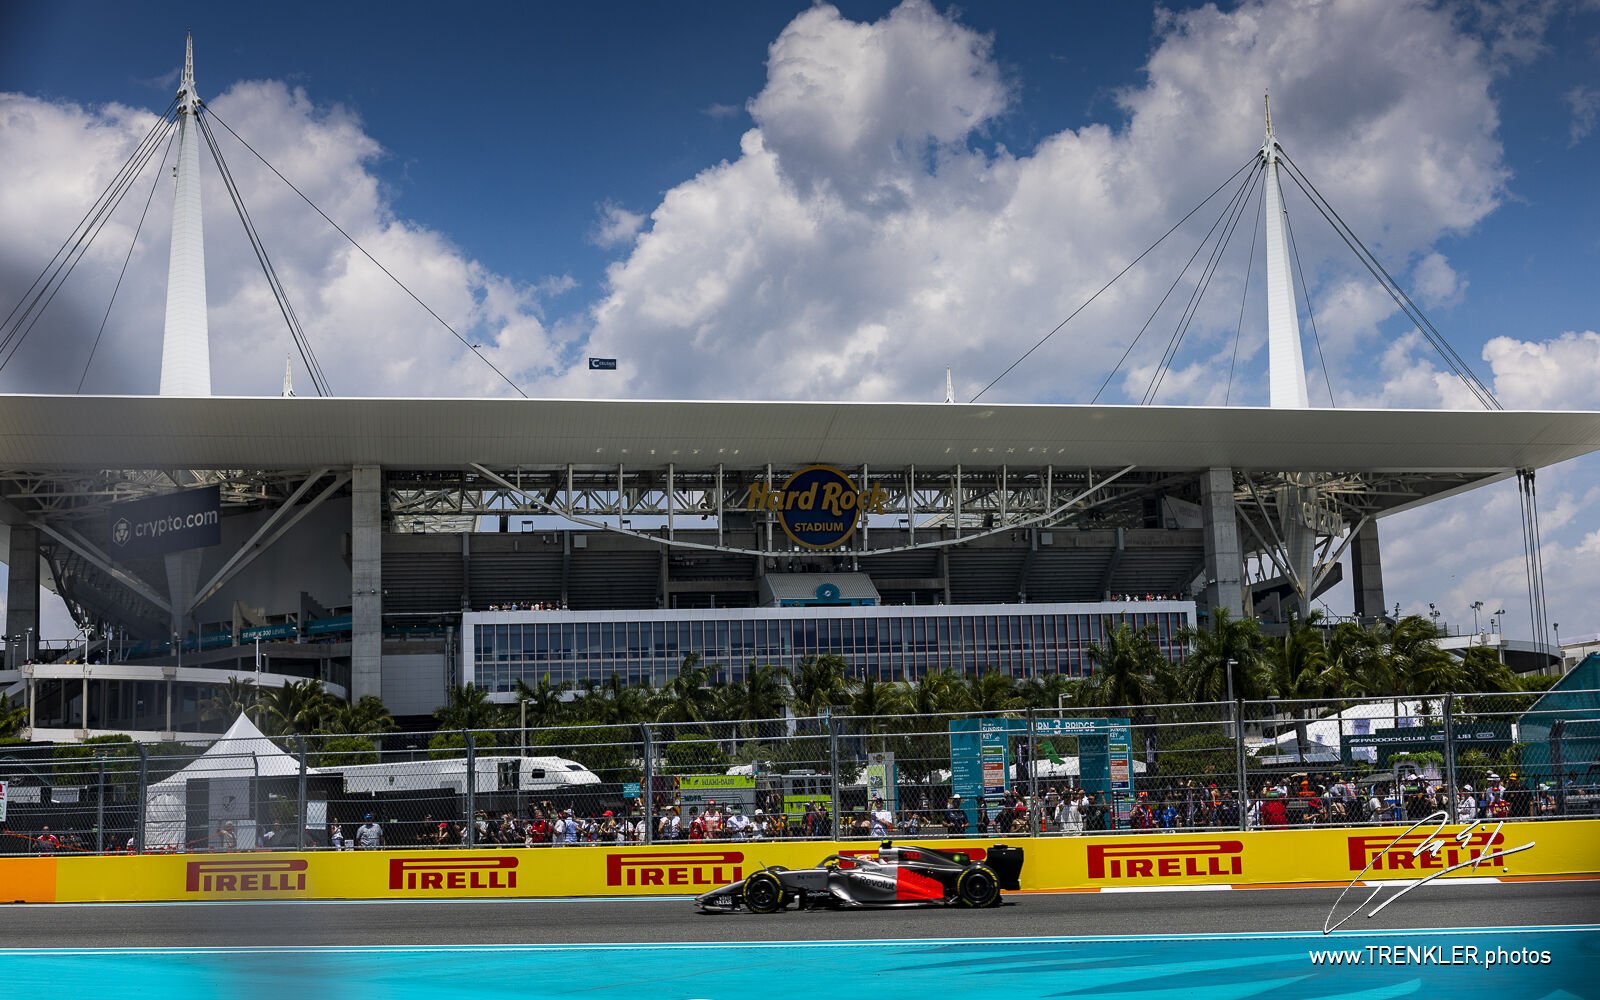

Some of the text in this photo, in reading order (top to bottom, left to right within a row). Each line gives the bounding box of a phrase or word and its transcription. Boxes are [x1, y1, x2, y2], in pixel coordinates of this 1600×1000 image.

[747, 480, 887, 516] Hard Rock
[135, 510, 218, 538] crypto.com
[794, 522, 844, 532] STADIUM
[1053, 719, 1062, 735] 3
[1065, 721, 1095, 732] BRIDGE
[1087, 840, 1243, 879] PIRELLI
[1347, 832, 1505, 871] PIRELLI
[186, 860, 308, 892] PIRELLI
[389, 857, 519, 889] PIRELLI
[607, 852, 745, 886] PIRELLI
[859, 876, 895, 890] Revolut
